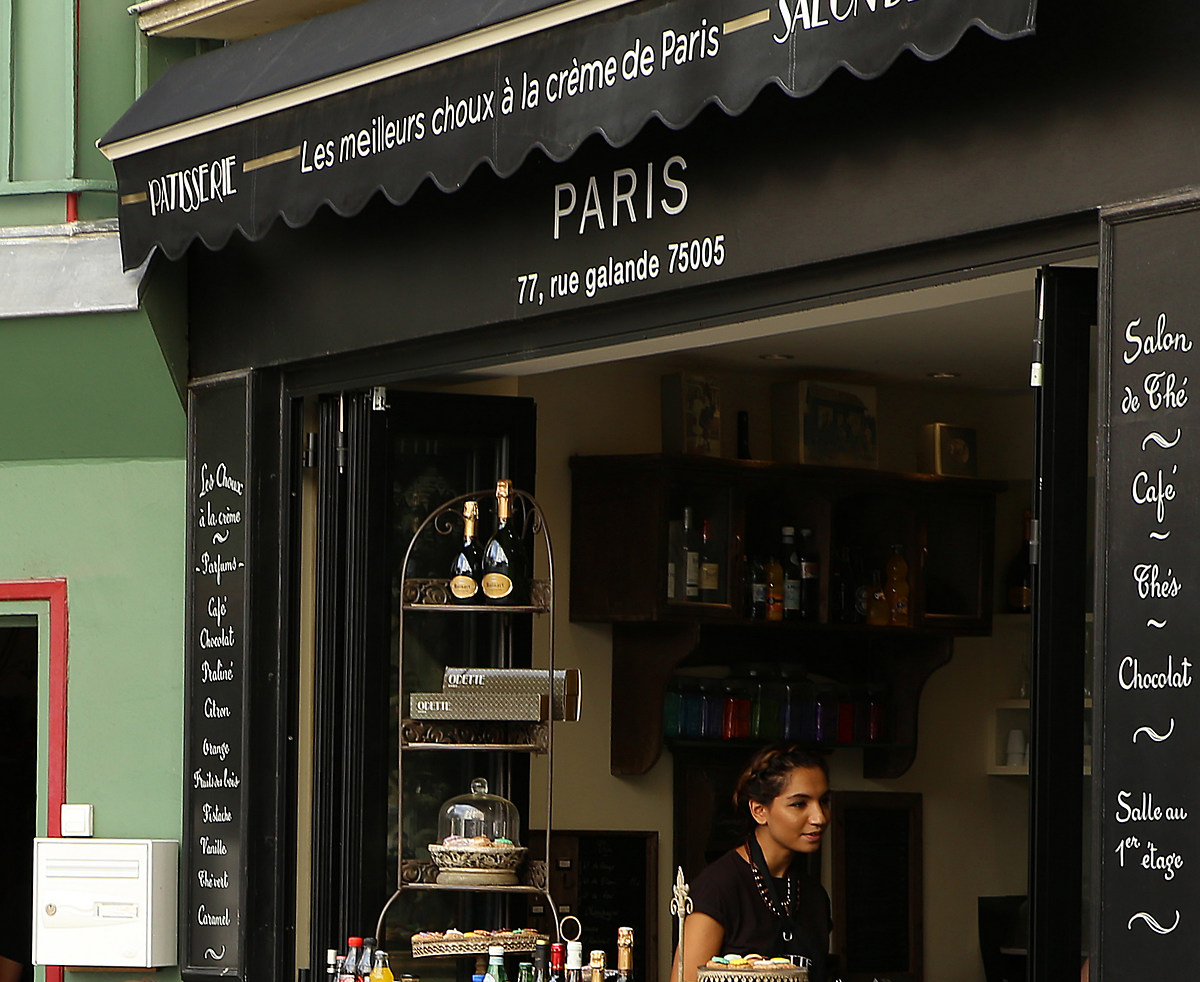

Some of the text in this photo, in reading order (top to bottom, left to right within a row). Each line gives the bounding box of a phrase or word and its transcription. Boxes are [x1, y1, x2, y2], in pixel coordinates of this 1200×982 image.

[301, 18, 720, 173] Les meilleurs choux à la crème de Paris
[149, 155, 237, 216] PATISSERIE
[553, 155, 688, 239] PARIS
[517, 234, 725, 306] 77, rue galande 75005
[1123, 312, 1193, 364] Salon
[1121, 371, 1188, 414] de Thé
[216, 463, 244, 496] Choux
[1132, 465, 1178, 523] Café
[199, 501, 241, 527] à la crème
[1133, 564, 1182, 599] Thés
[208, 596, 227, 627] Café
[200, 626, 234, 649] Chocolat
[201, 659, 233, 683] Praliné
[1118, 655, 1192, 690] Chocolat
[204, 697, 230, 718] Citron
[203, 738, 230, 761] Orange
[1115, 790, 1188, 824] Salle au
[200, 836, 228, 855] Vanille
[1141, 841, 1184, 881] étage
[198, 904, 231, 926] Caramel
